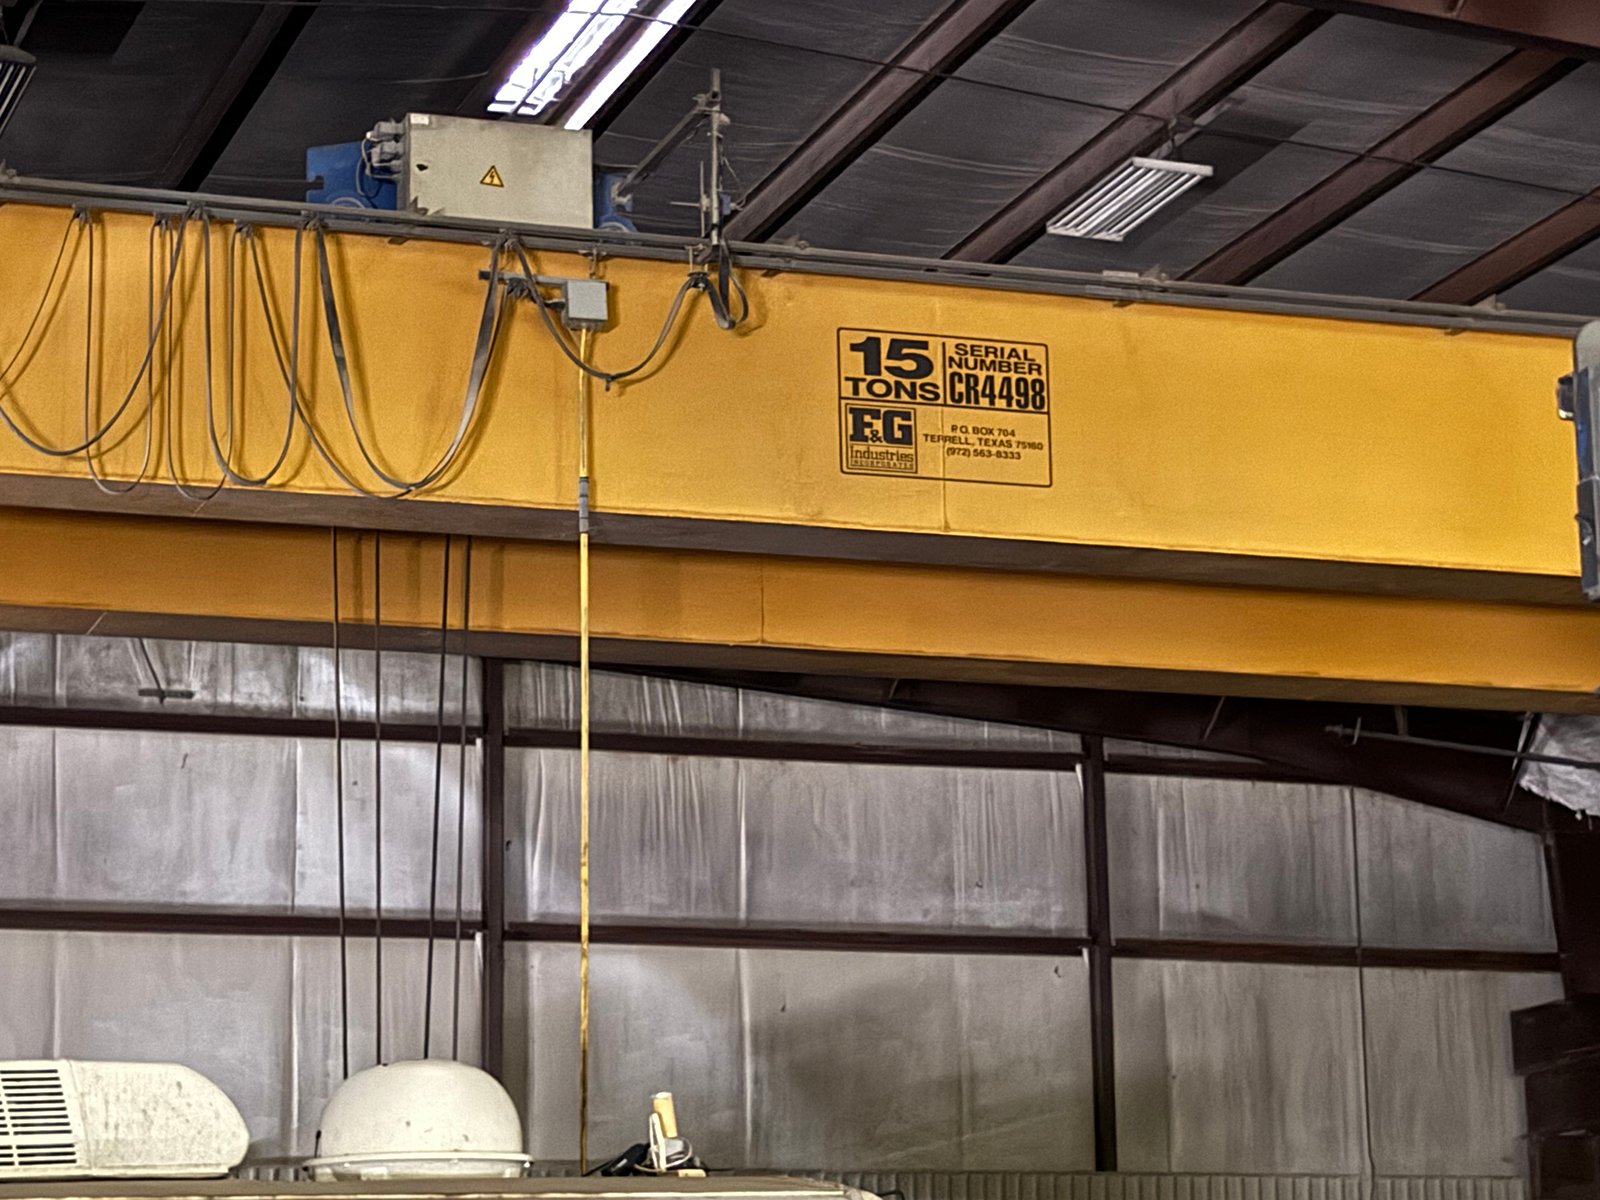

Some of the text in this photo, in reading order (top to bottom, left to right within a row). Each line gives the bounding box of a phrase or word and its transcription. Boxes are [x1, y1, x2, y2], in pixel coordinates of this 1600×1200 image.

[849, 336, 934, 379] 15
[954, 343, 1036, 362] SERIAL
[948, 356, 1042, 376] NUMBER
[844, 376, 941, 401] TONS
[949, 371, 1045, 410] CR4498
[849, 407, 913, 446] F&G
[972, 426, 995, 437] BOX
[997, 428, 1016, 437] 704
[946, 447, 971, 458] (972)
[977, 437, 1013, 449] TEXAS
[850, 445, 914, 463] Industries
